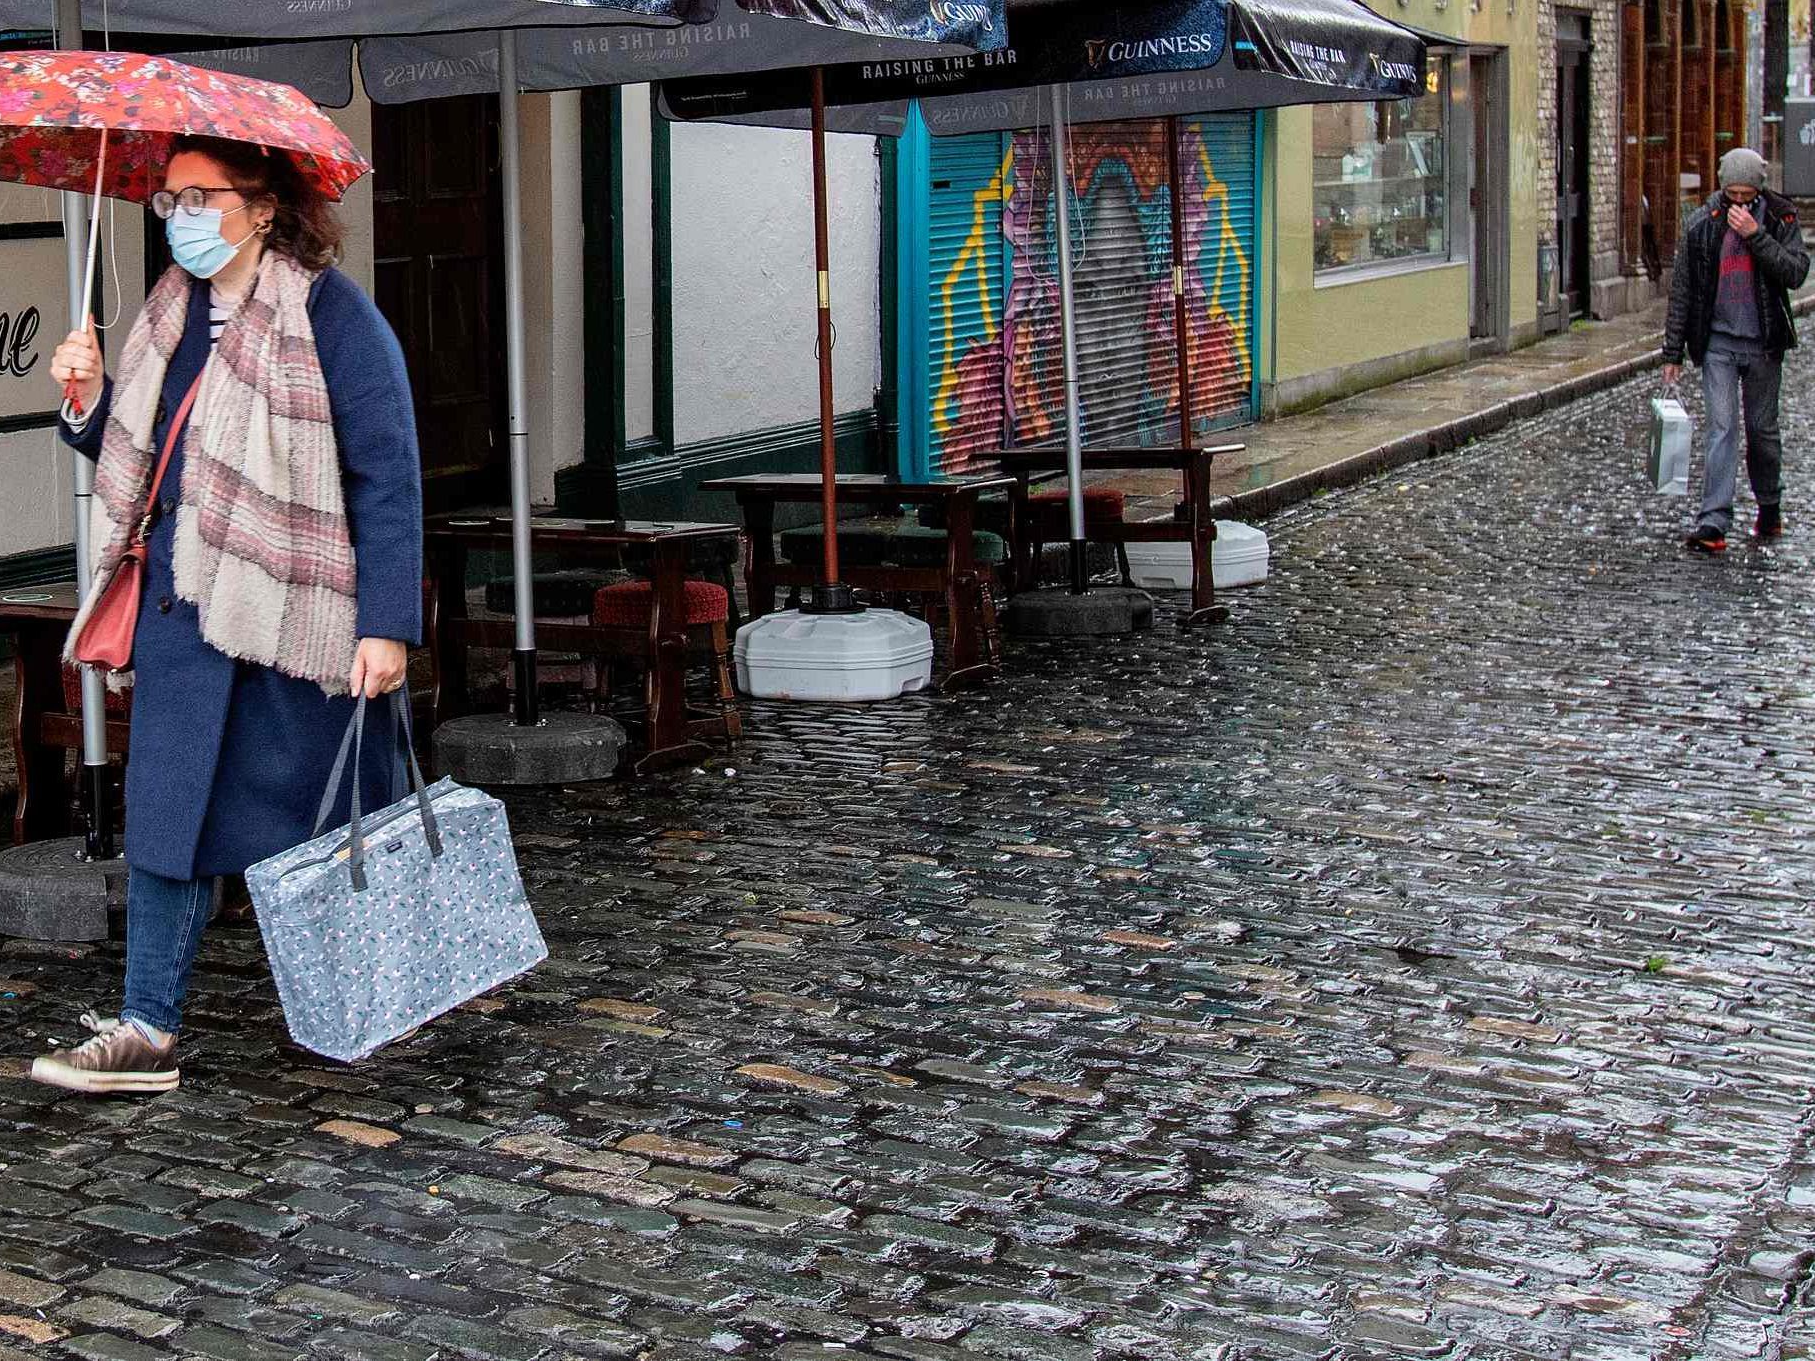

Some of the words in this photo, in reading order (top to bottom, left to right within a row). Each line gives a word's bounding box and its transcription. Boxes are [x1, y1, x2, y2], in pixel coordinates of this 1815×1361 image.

[1108, 33, 1213, 62] GUINNESS
[1315, 45, 1329, 62] THE
[862, 60, 934, 79] RAISING
[943, 56, 977, 72] THE
[983, 50, 1018, 67] BAR
